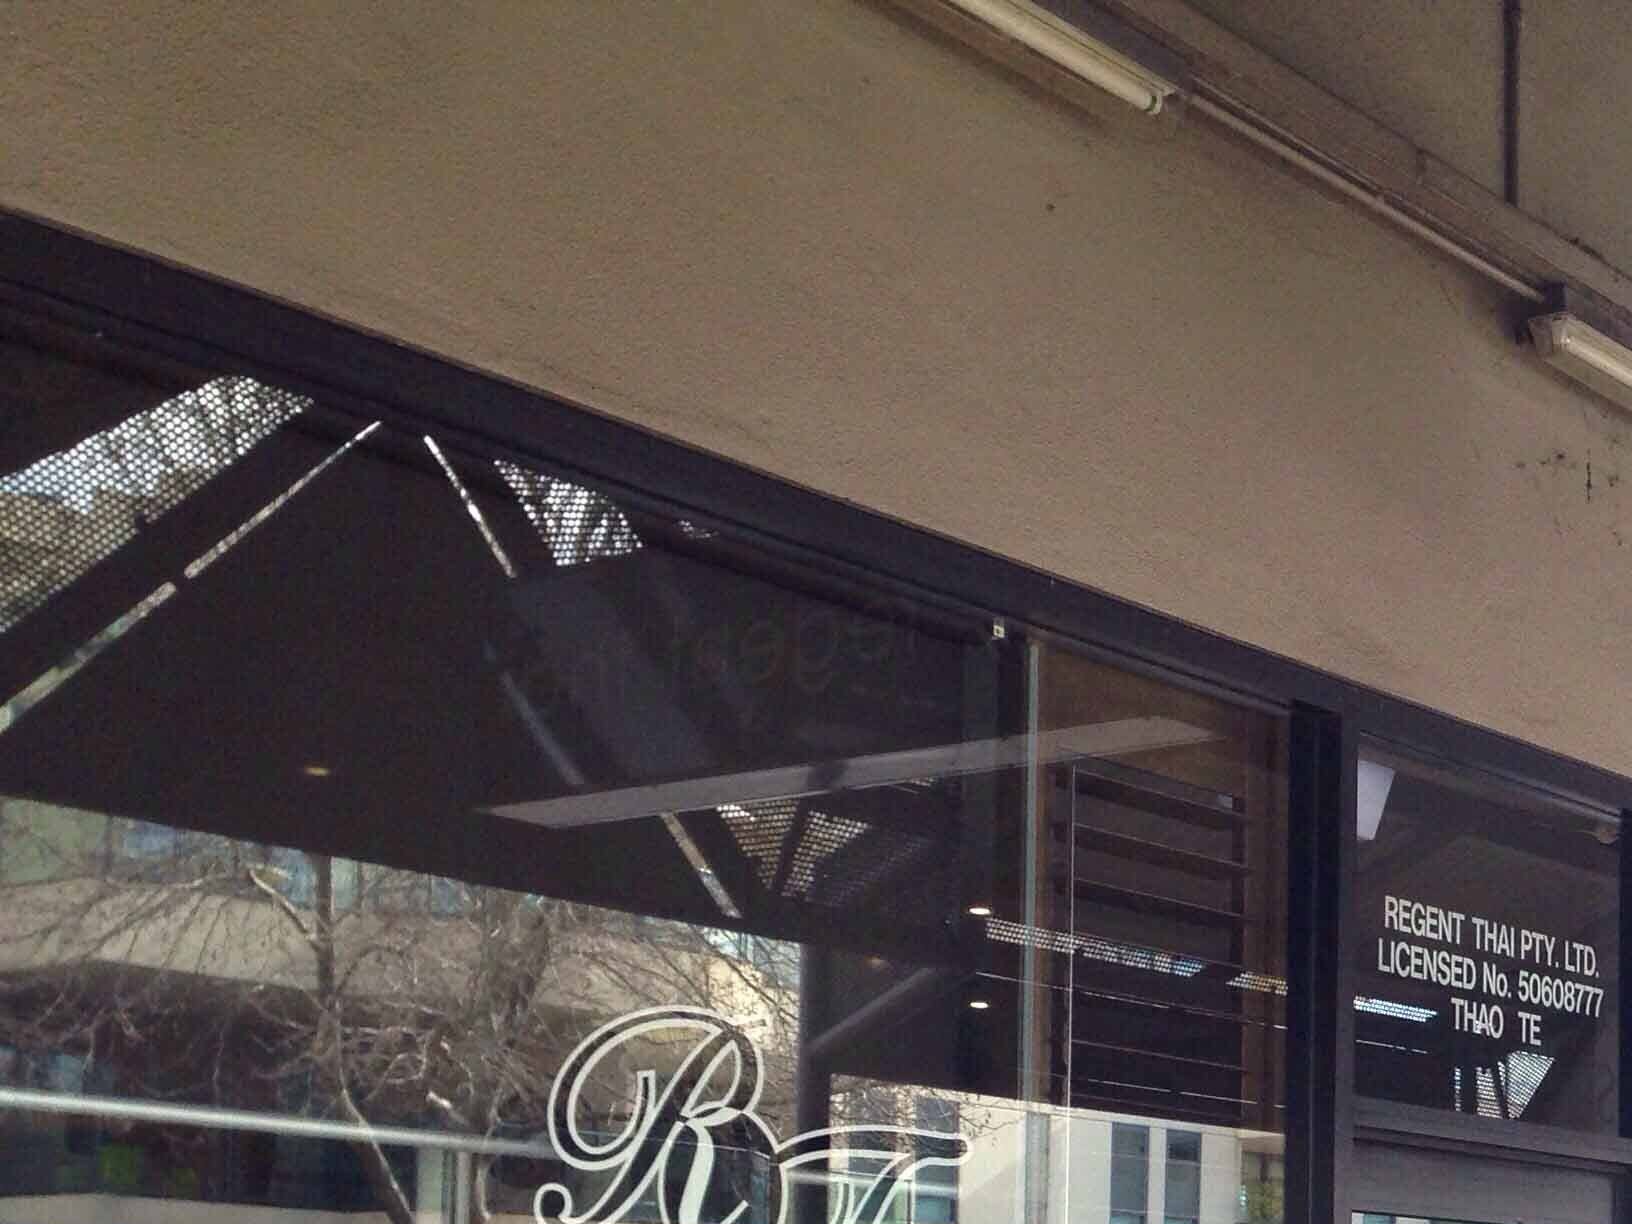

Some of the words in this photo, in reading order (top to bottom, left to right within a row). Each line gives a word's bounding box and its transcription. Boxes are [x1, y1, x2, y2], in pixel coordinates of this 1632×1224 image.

[1384, 895, 1465, 944] REGENT
[1472, 917, 1517, 957] THAI
[1520, 929, 1560, 967] PTY.
[1564, 941, 1600, 978] LTD.
[1377, 938, 1476, 990] LICENSED
[1482, 961, 1512, 999] No.
[1517, 970, 1604, 1018] 50608777
[1451, 996, 1505, 1039] THAO
[1518, 1011, 1542, 1046] TE
